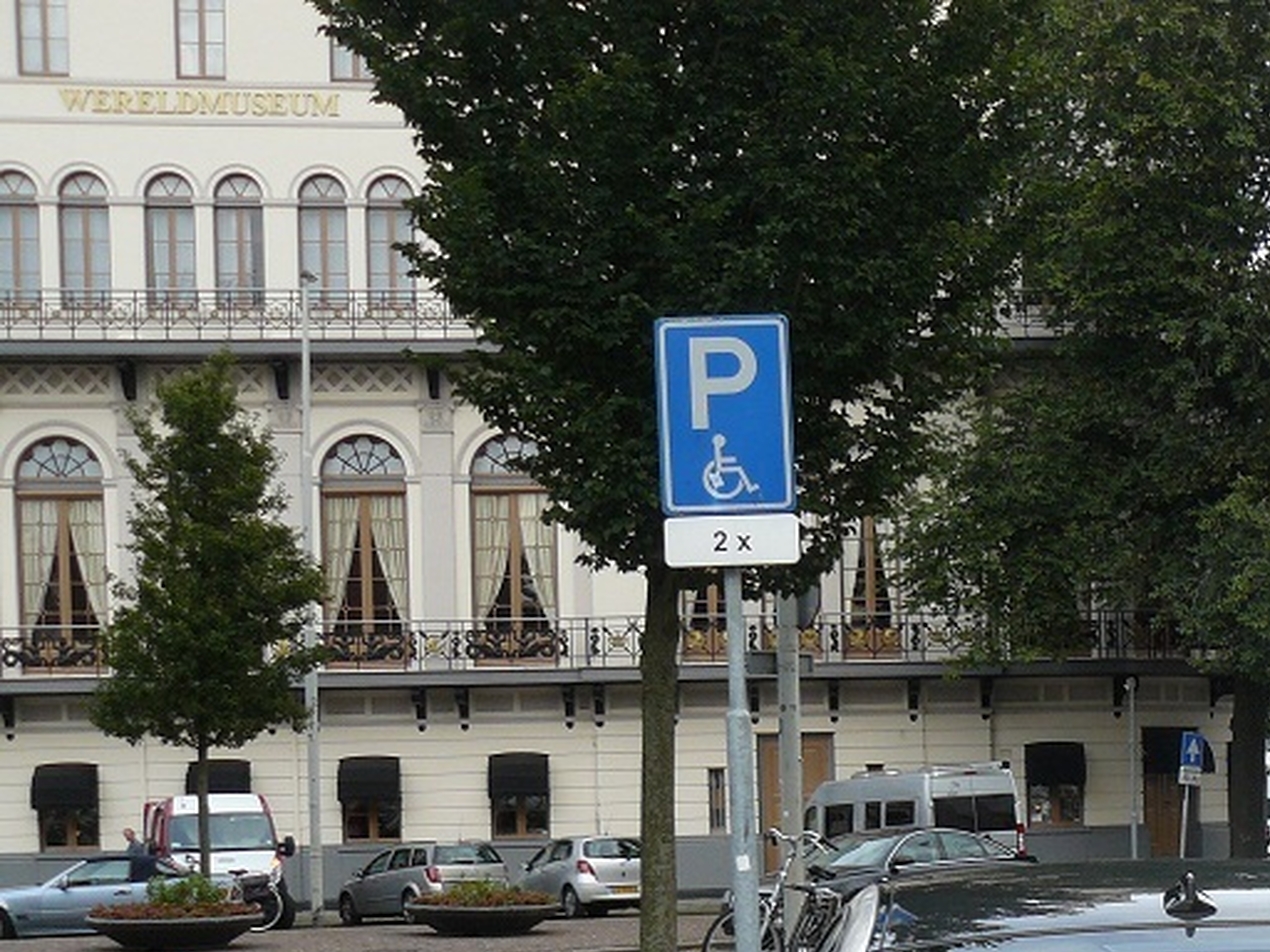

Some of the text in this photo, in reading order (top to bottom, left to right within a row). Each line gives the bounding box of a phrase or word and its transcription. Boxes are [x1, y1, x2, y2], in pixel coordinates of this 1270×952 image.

[58, 88, 341, 118] WERELDMUSEUM
[688, 336, 758, 430] P
[713, 530, 752, 552] 2 x
